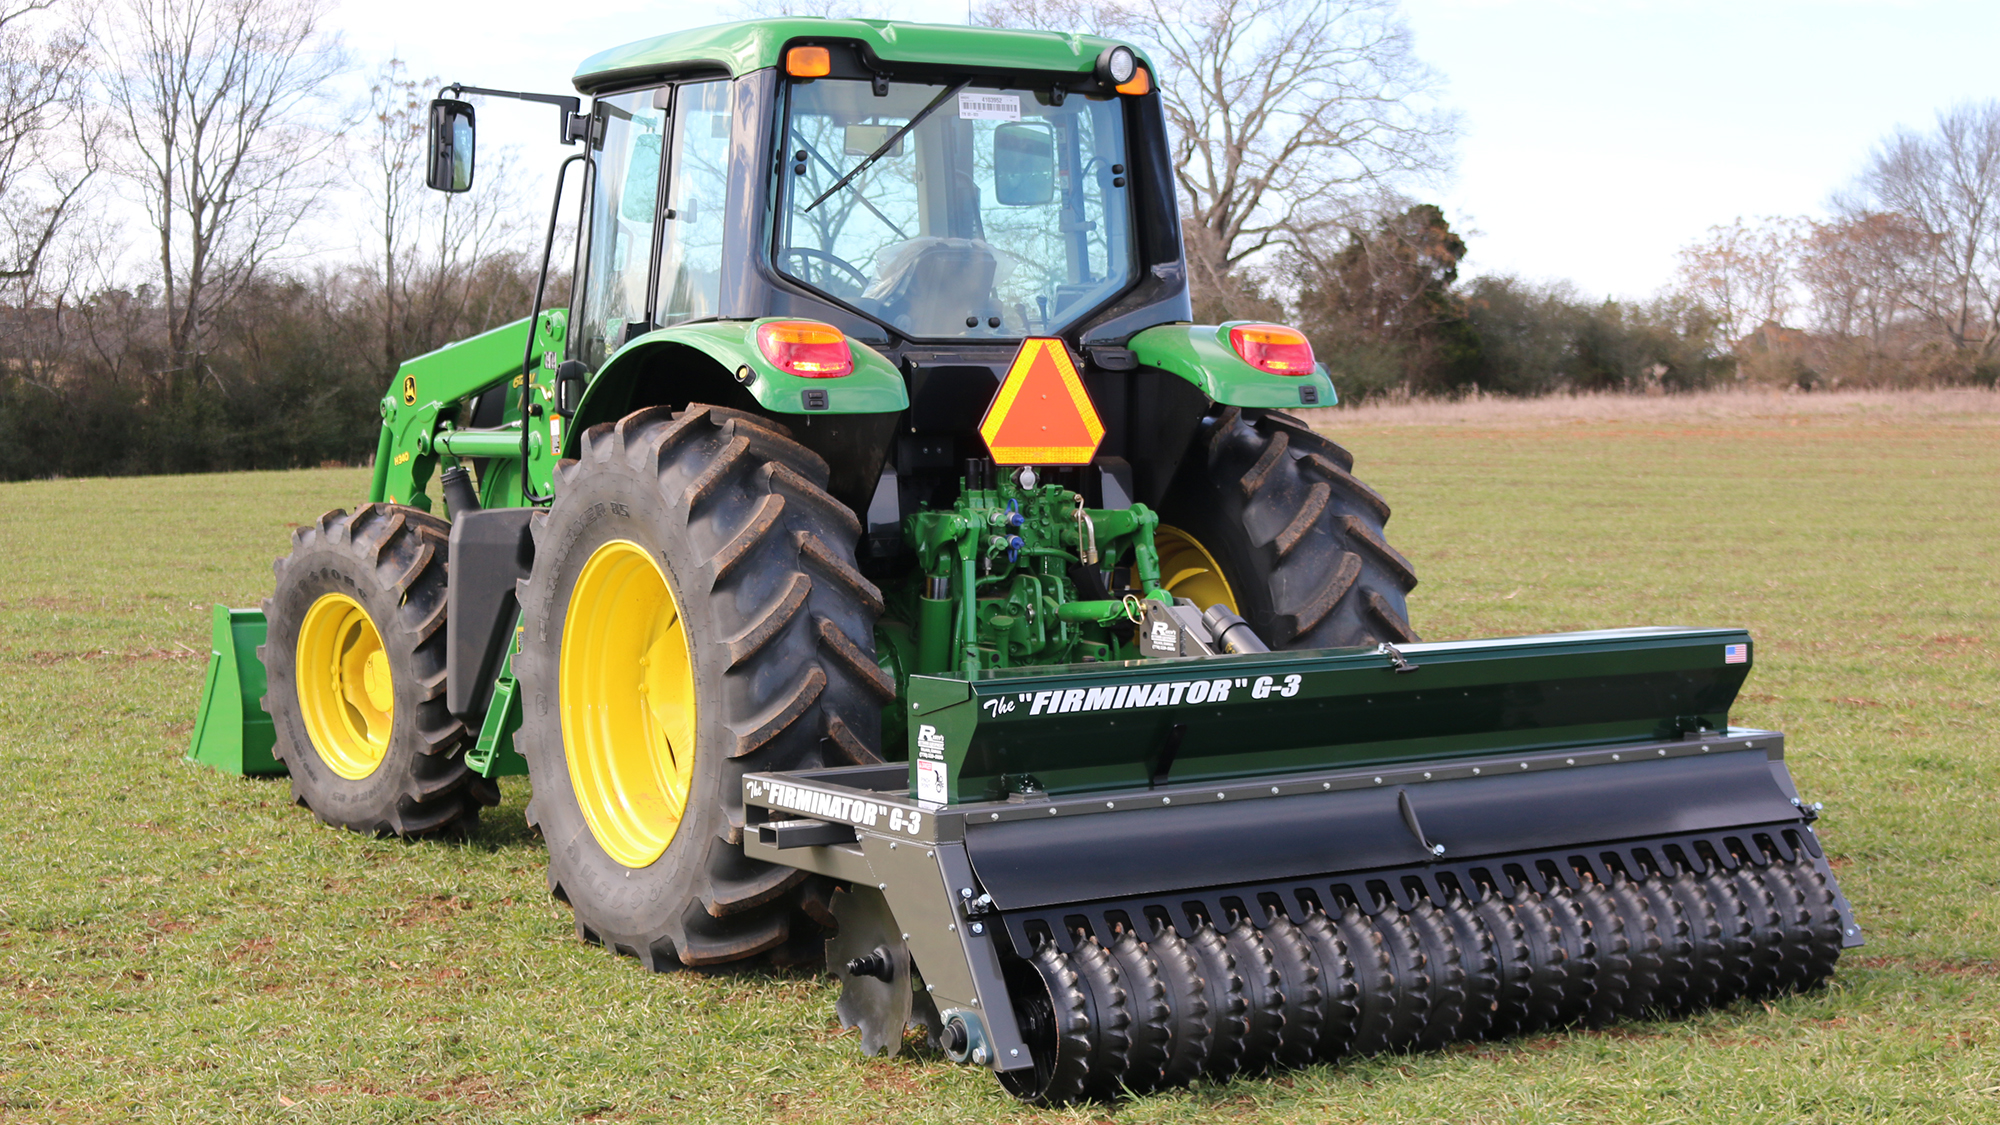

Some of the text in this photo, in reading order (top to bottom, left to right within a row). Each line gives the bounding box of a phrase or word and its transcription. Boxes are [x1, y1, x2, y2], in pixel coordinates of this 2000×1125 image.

[393, 450, 410, 466] H340
[610, 502, 631, 519] 85
[983, 674, 1302, 718] The "FIRMINATOR" G-3
[745, 780, 922, 836] The "FIRMINATOR" G-3
